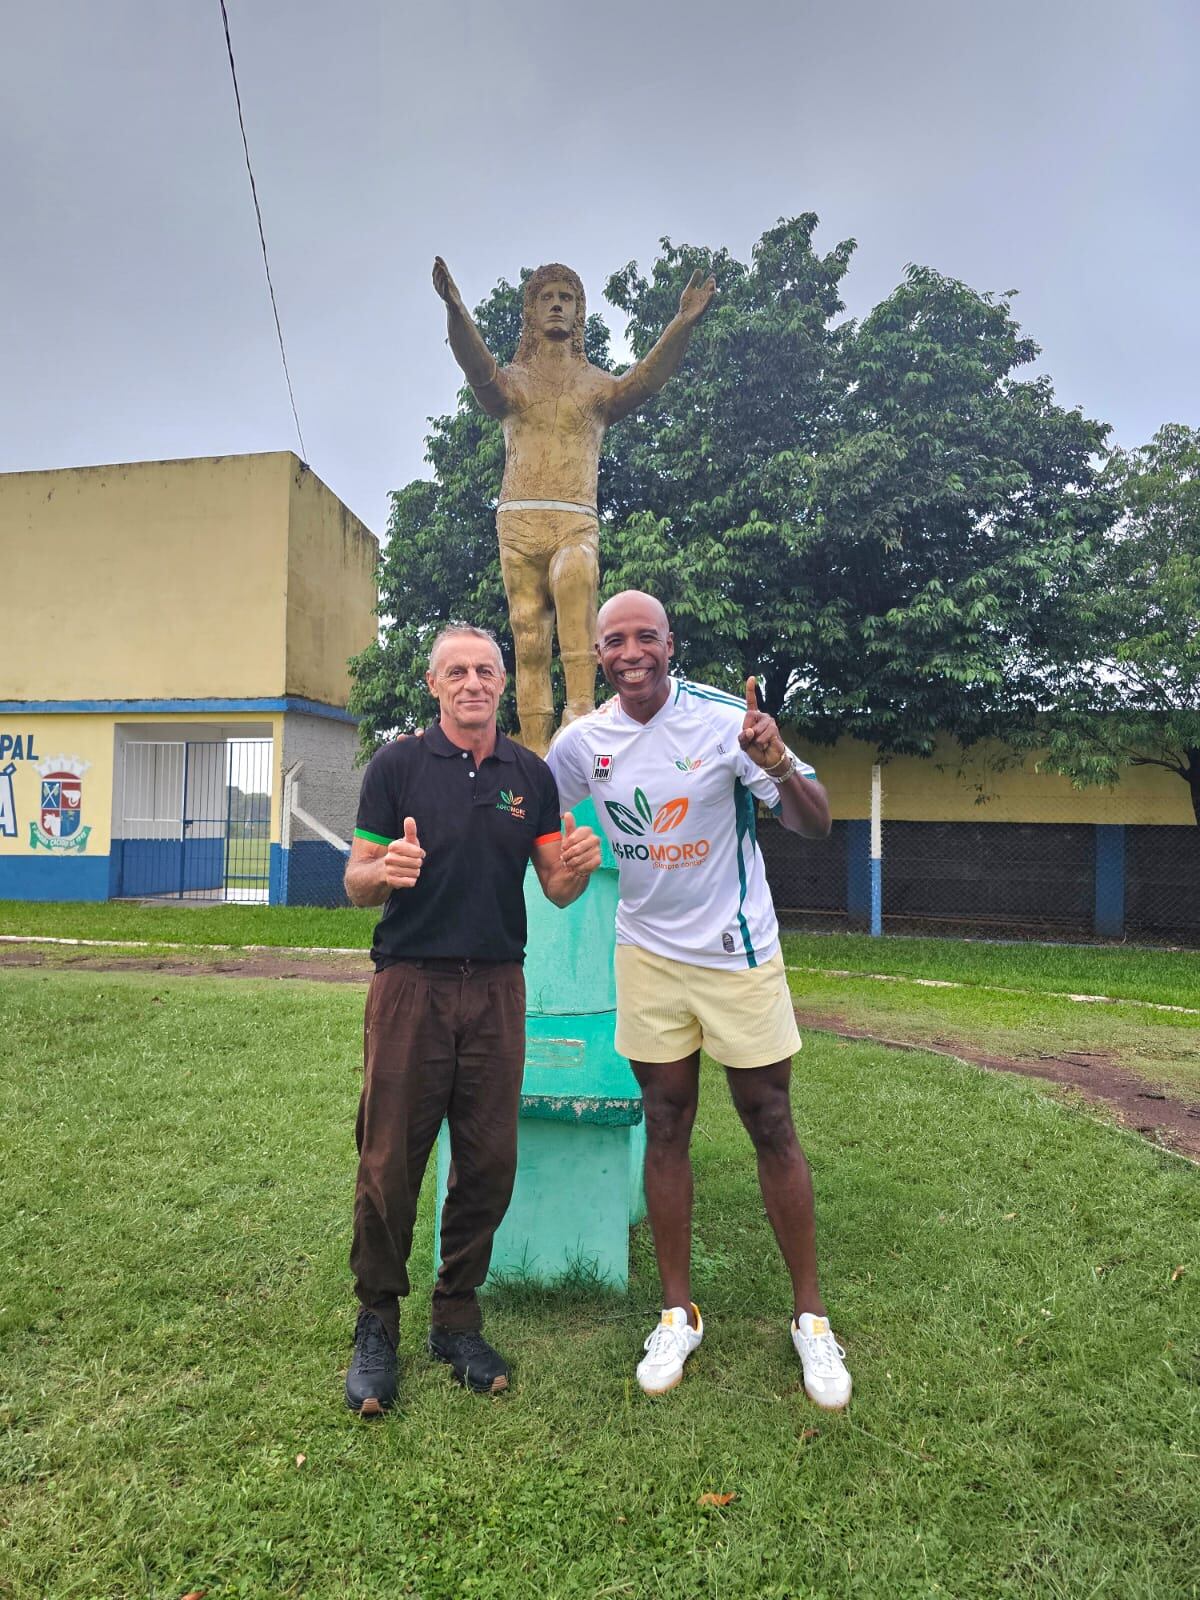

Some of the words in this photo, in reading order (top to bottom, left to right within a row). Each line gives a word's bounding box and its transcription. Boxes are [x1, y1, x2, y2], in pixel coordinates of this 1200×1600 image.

[0, 734, 39, 760] PAL
[596, 756, 601, 767] I
[594, 768, 610, 778] RUN
[612, 839, 710, 862] AGROMORO
